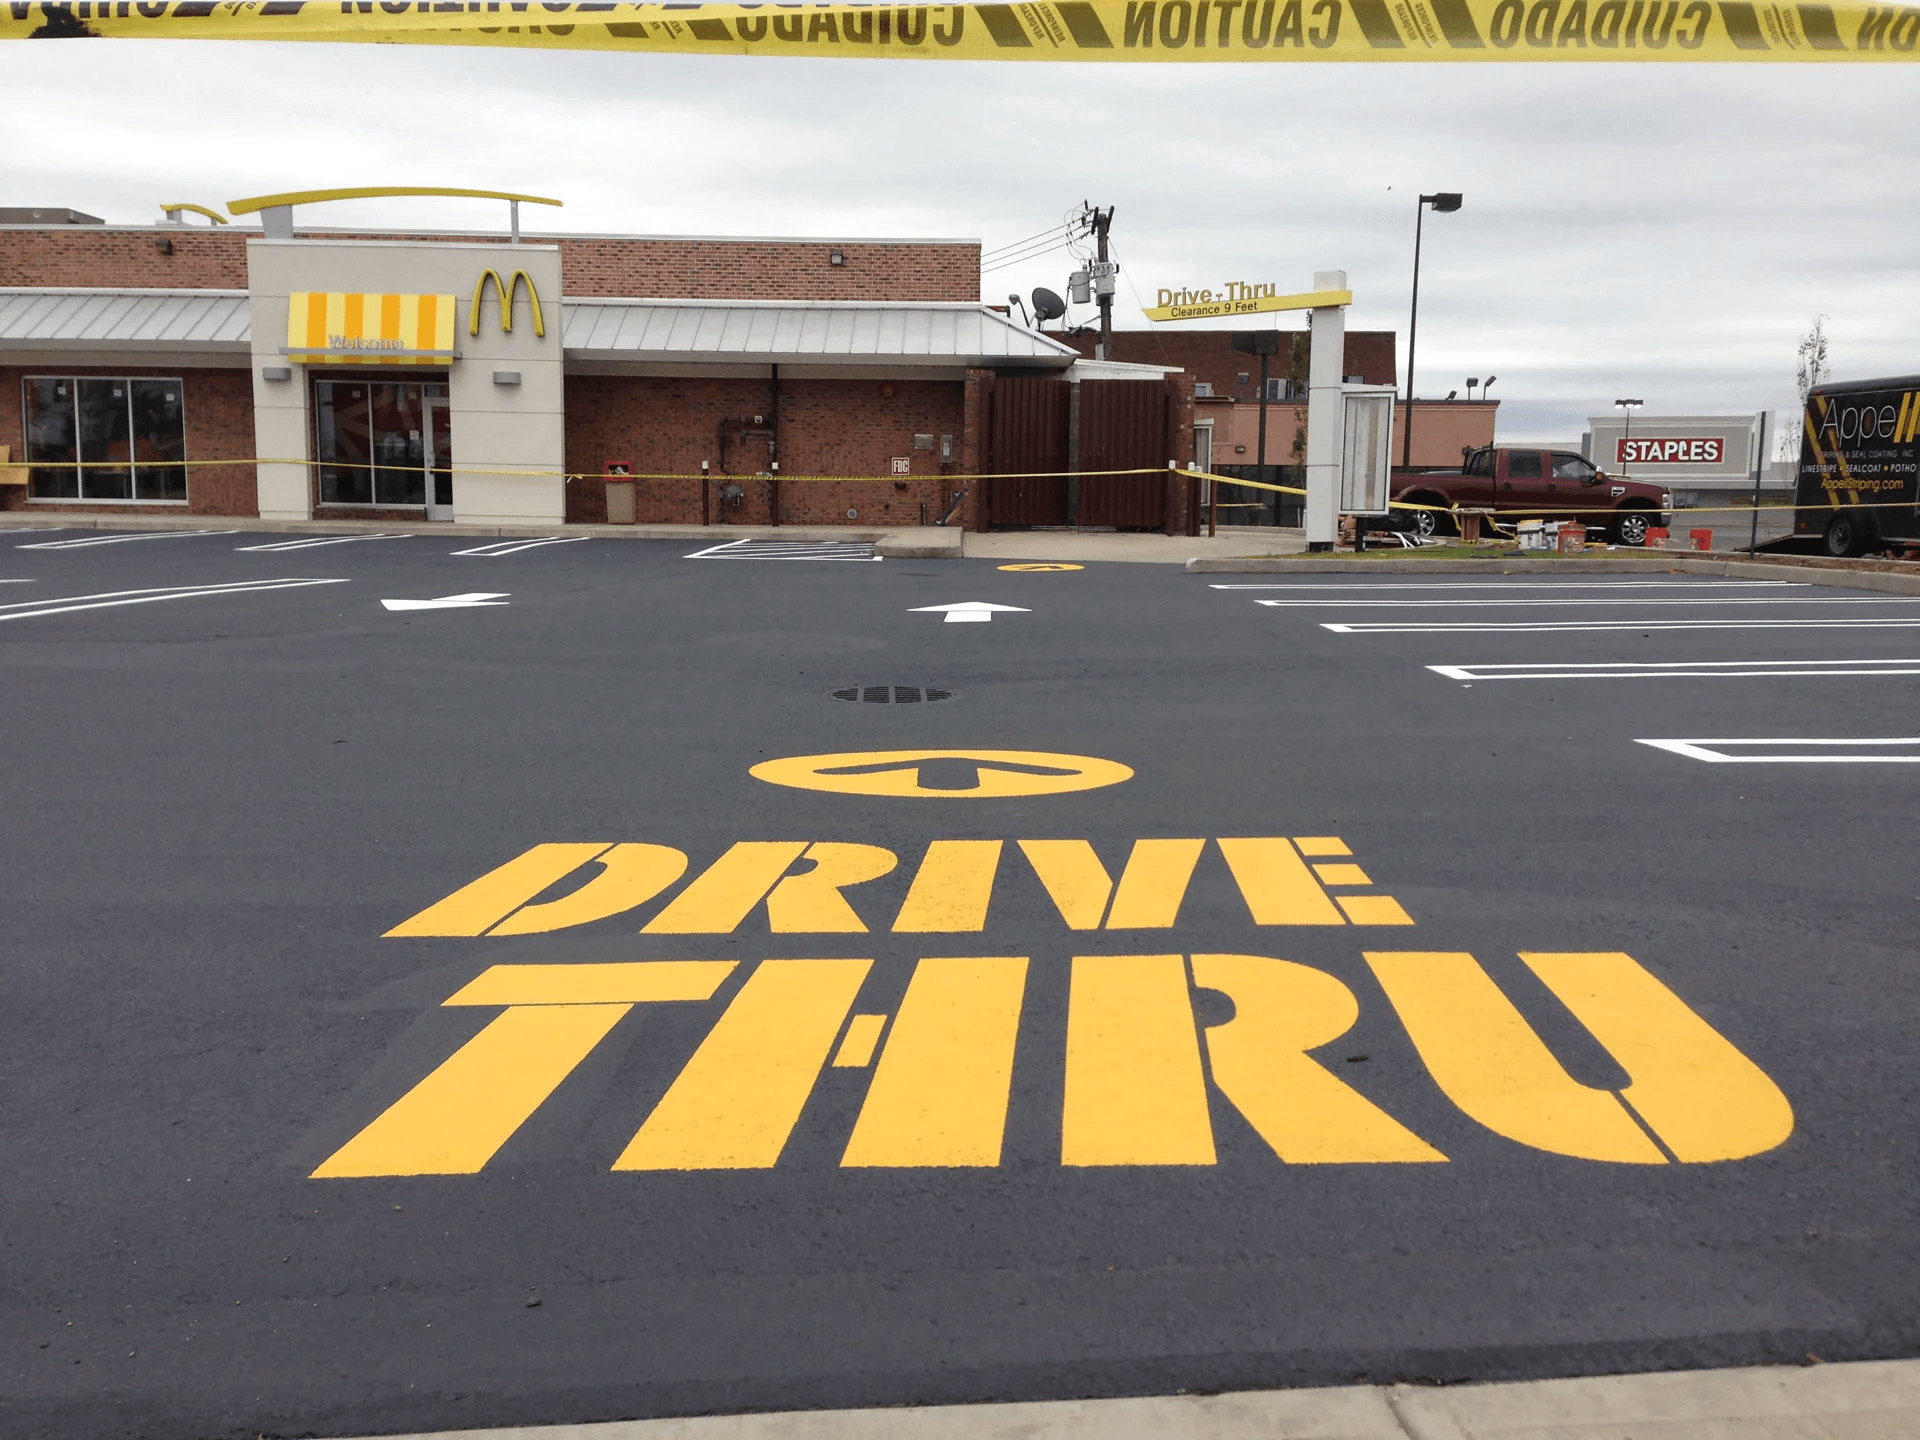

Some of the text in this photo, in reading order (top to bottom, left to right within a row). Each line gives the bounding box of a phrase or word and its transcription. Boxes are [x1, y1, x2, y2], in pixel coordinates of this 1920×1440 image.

[1171, 301, 1257, 318] Clearance 9 Feet
[328, 334, 404, 350] Welcome
[1623, 440, 1719, 461] STAPLES
[1869, 450, 1897, 458] COATING
[893, 460, 908, 473] FDC
[1802, 464, 1837, 473] LINESTRIPE
[1846, 463, 1881, 473] SEALCOAT
[382, 837, 1414, 938] DRIVE
[308, 952, 1794, 1180] THRU
